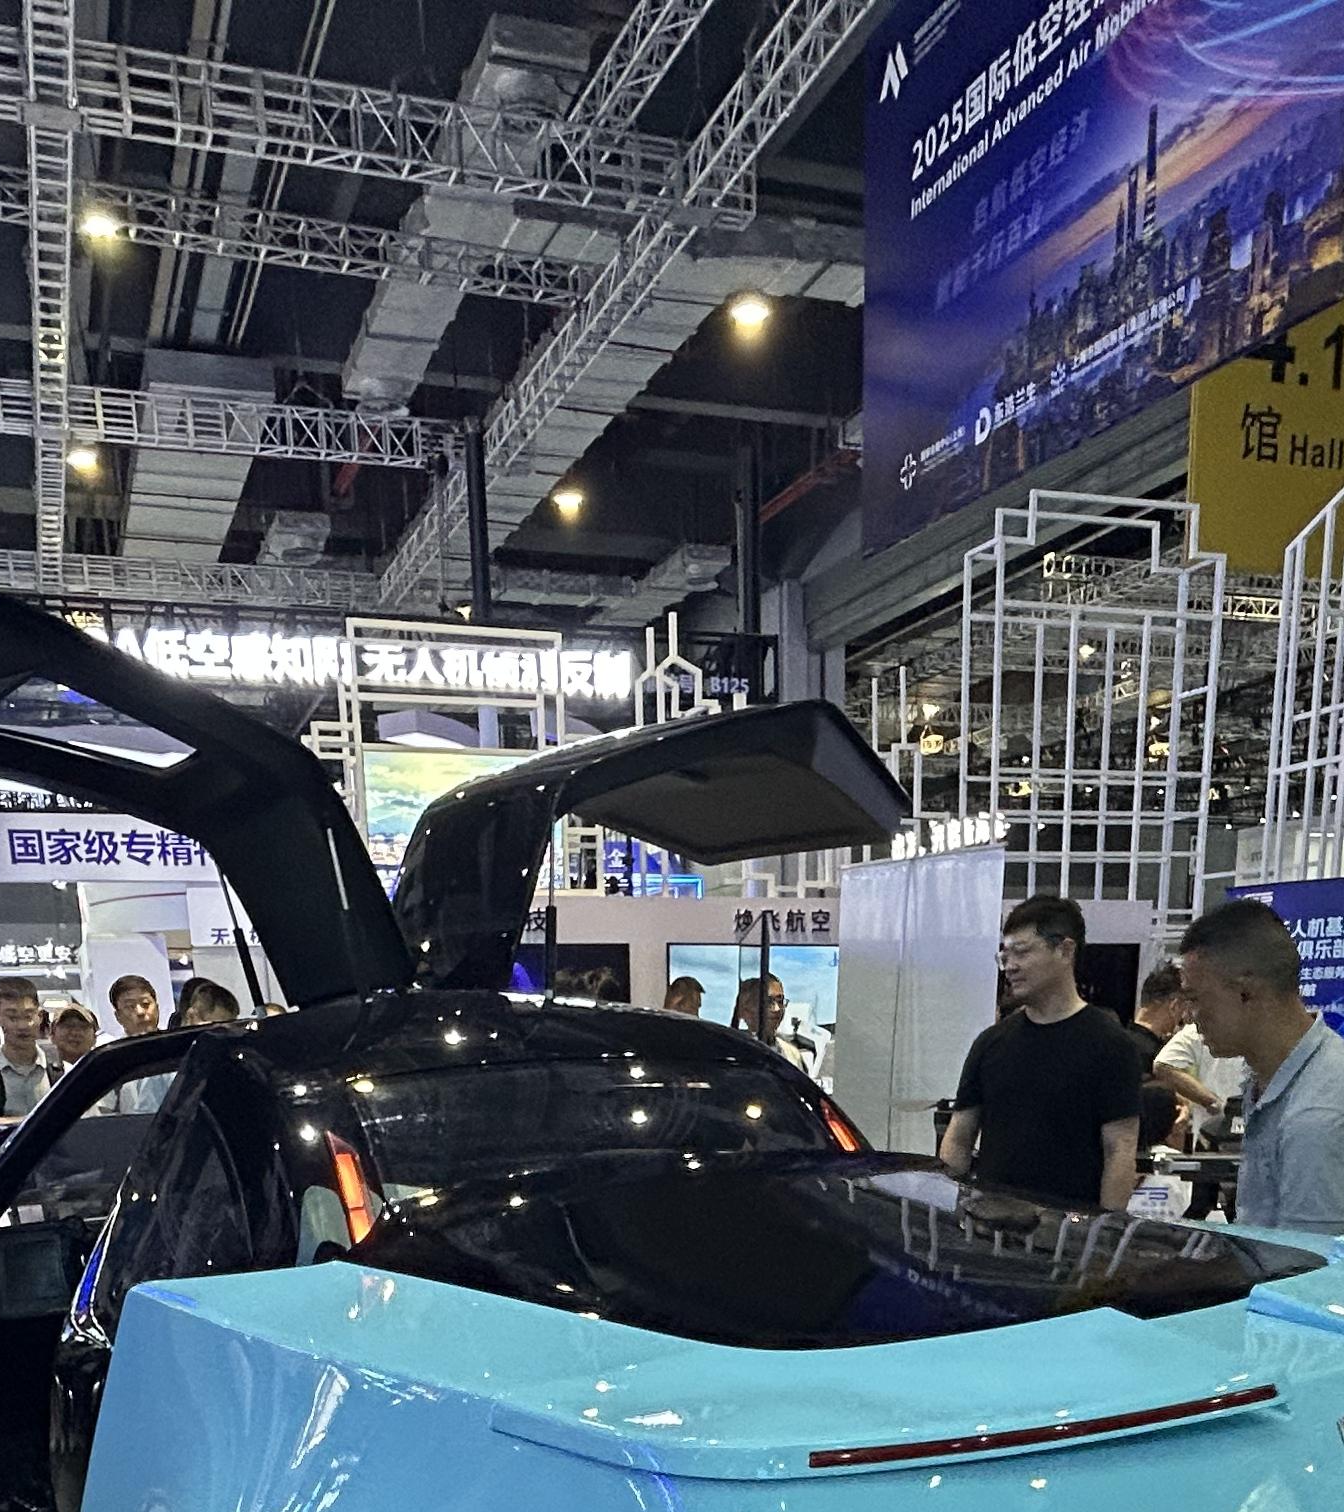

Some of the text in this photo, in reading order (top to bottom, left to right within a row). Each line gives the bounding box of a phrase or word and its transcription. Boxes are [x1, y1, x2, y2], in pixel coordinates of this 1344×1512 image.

[912, 0, 1106, 182] 2025国际低空经
[910, 128, 989, 221] International
[991, 59, 1063, 147] Advanced
[1067, 39, 1092, 78] Air
[1241, 403, 1282, 464] 馆
[1289, 433, 1344, 470] Hall
[709, 675, 750, 695] B125
